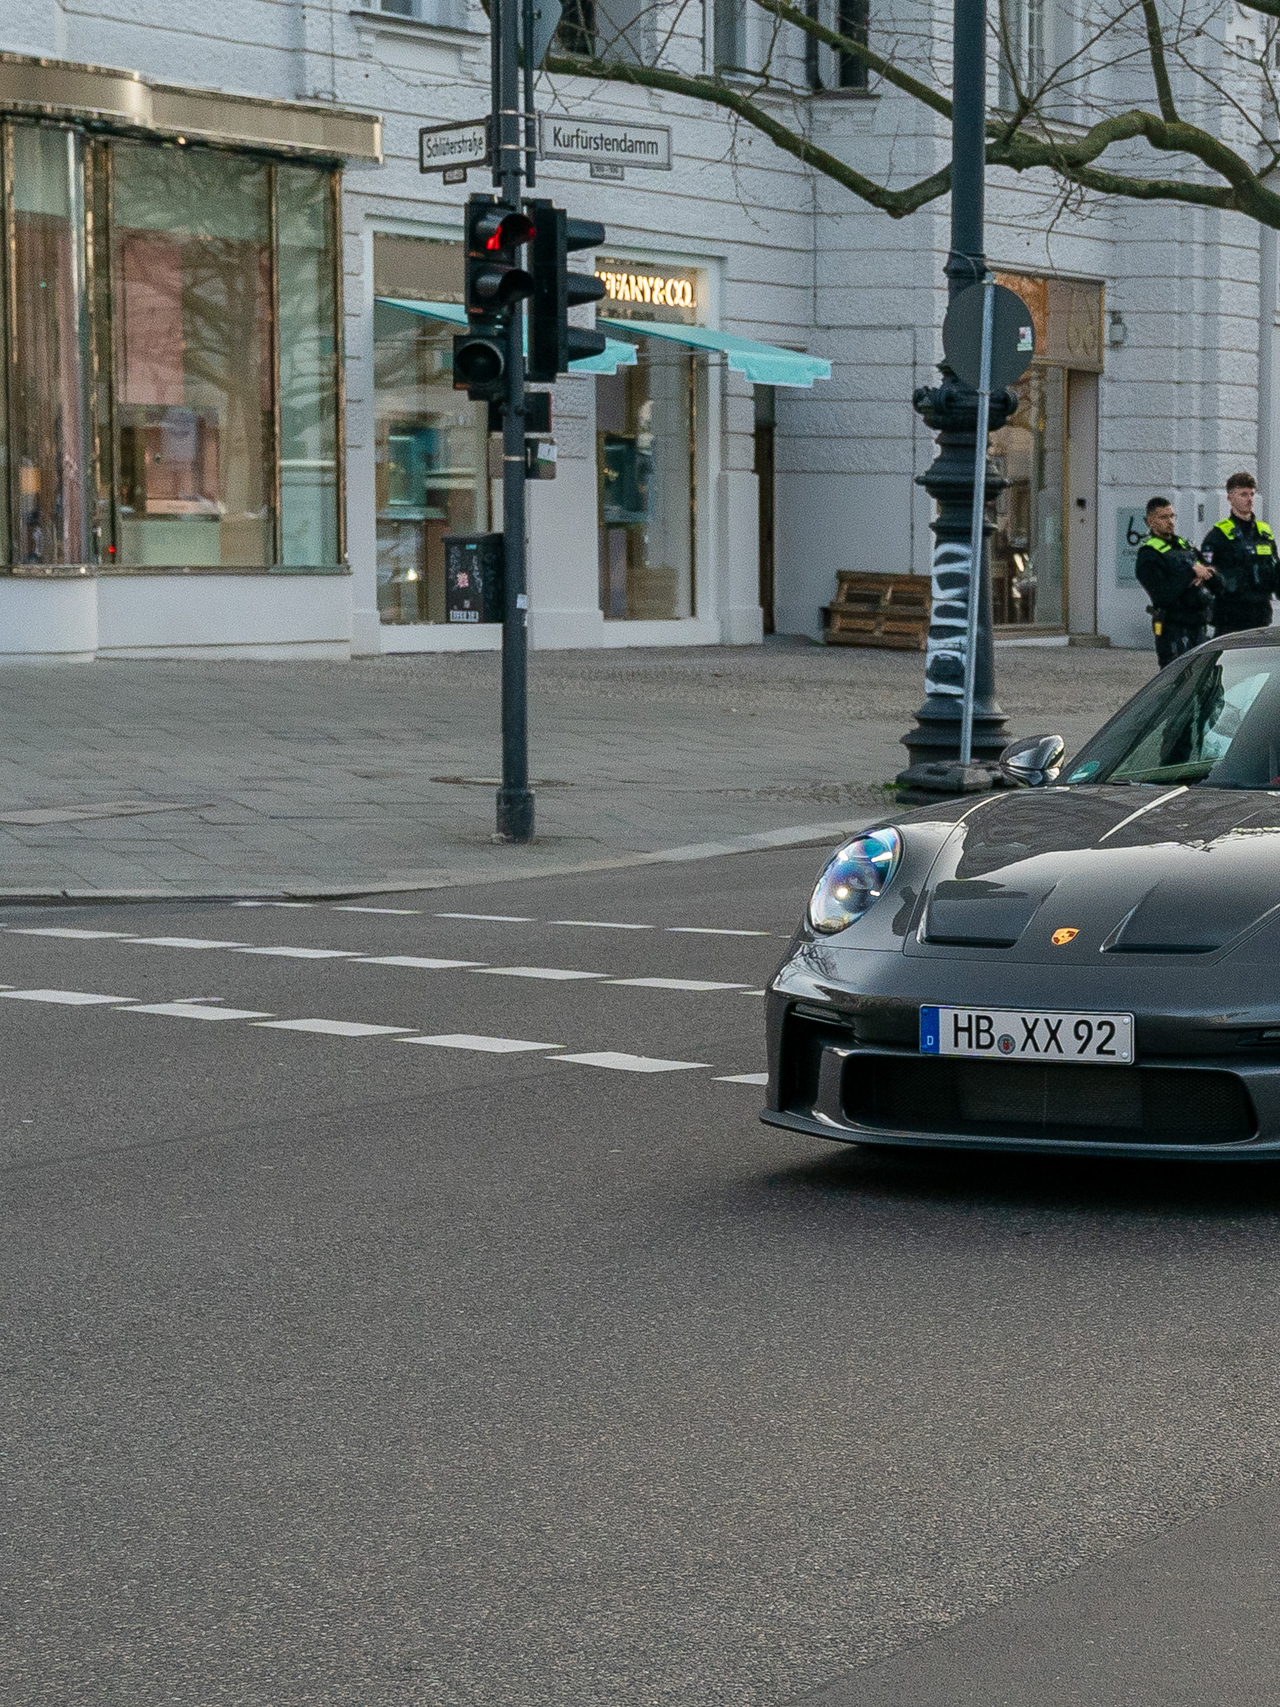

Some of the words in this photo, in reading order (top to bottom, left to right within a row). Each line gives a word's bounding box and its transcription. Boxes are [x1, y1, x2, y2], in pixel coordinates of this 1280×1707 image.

[552, 128, 659, 155] Kurfürstendamm
[953, 1013, 995, 1050] HB
[1020, 1016, 1064, 1054] XX
[1073, 1019, 1116, 1056] 92
